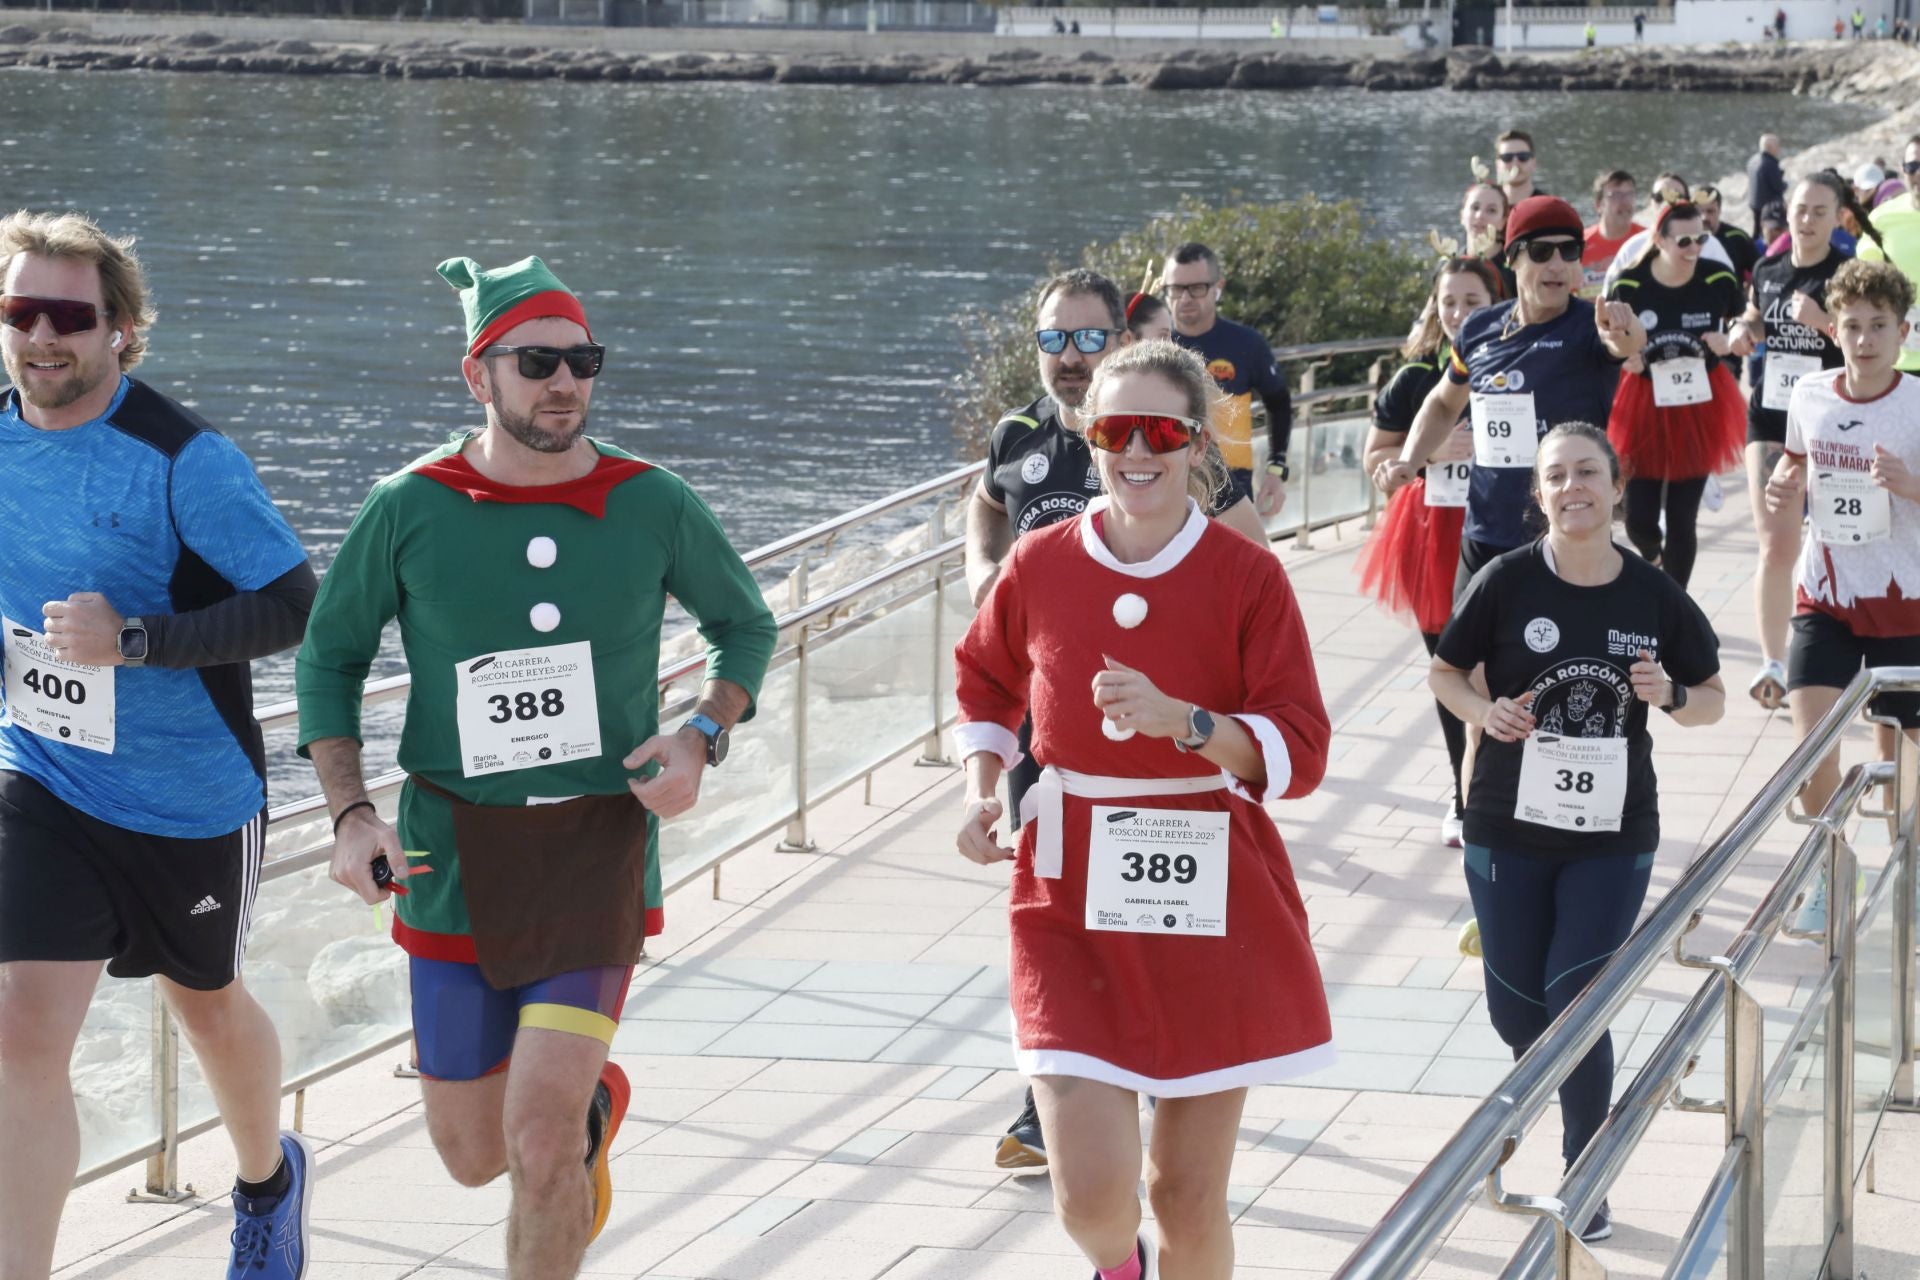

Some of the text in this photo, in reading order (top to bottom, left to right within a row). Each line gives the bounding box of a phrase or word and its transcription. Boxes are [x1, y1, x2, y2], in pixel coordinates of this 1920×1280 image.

[1780, 324, 1818, 337] CROSS
[1767, 336, 1825, 350] OCTURNO
[1671, 372, 1693, 385] 92
[1487, 420, 1512, 438] 69
[1443, 463, 1470, 480] 10
[1834, 498, 1862, 516] 28
[1608, 629, 1649, 646] Marina
[1627, 645, 1657, 660] Déia
[43, 652, 53, 662] DE
[82, 664, 101, 673] 2025
[492, 655, 551, 669] XI CARRERA
[511, 670, 524, 679] DE
[526, 665, 555, 677] REYES
[557, 663, 578, 672] 2025
[1556, 664, 1620, 685] ROSCÓN
[23, 668, 86, 705] 400
[1616, 683, 1631, 702] DE
[487, 688, 565, 724] 388
[36, 707, 71, 720] CHRISTIAN
[1614, 702, 1628, 738] EYE
[511, 733, 549, 743] ENERGICO
[1566, 744, 1601, 753] CARRERA
[473, 753, 497, 763] Marina
[1580, 753, 1602, 761] REYES
[484, 760, 504, 769] Dénia
[1554, 769, 1594, 793] 38
[1558, 802, 1585, 810] VANESSA
[1133, 818, 1190, 828] XI CARRERA
[1150, 830, 1163, 838] DE
[1165, 830, 1193, 839] REYES
[1195, 831, 1216, 840] 2025
[1120, 852, 1198, 884] 389
[190, 902, 221, 915] adidas
[1125, 898, 1162, 906] GABRIELA
[1097, 910, 1122, 919] Marina
[1108, 918, 1128, 926] Dénia
